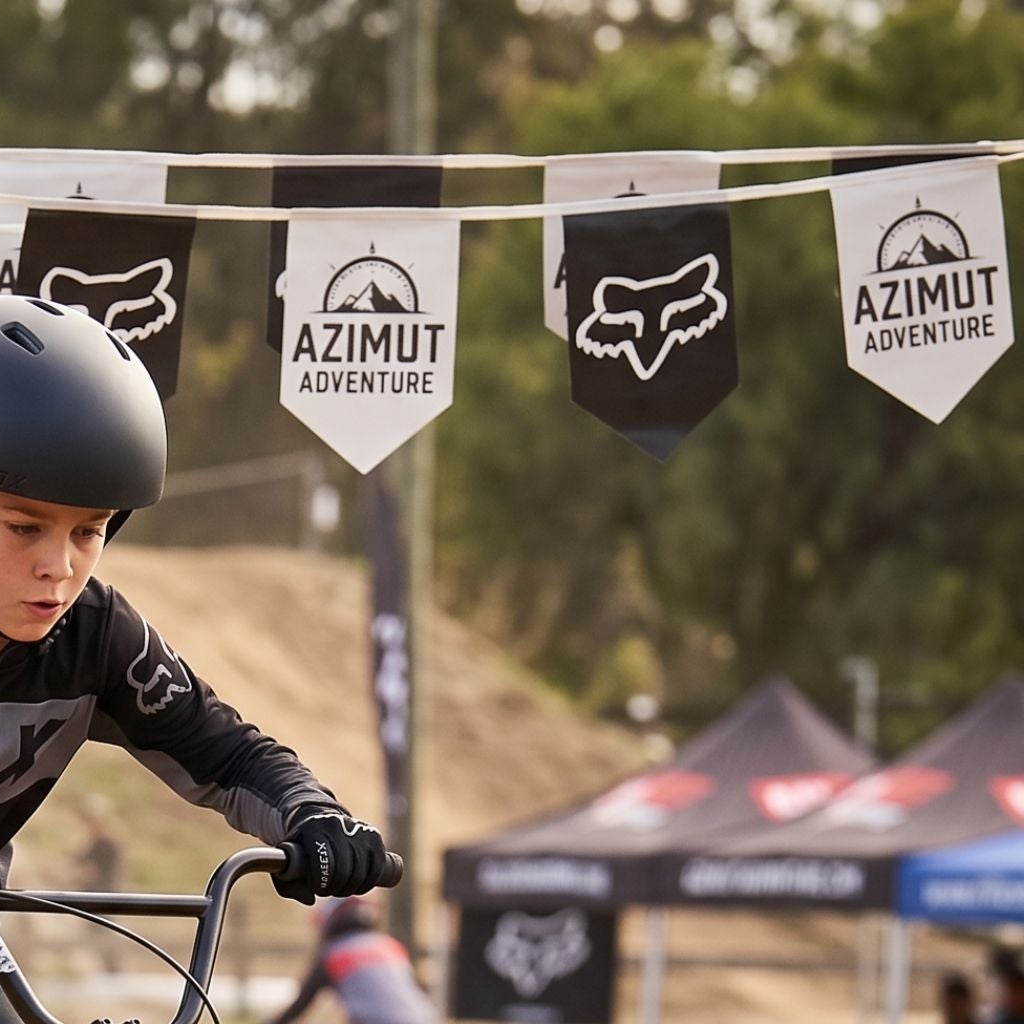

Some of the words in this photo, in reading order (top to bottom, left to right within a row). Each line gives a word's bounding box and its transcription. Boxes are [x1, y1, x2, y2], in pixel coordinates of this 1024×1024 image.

[854, 266, 998, 325] AZIMUT
[292, 323, 445, 363] AZIMUT
[864, 313, 995, 354] ADVENTURE
[299, 371, 434, 394] ADVENTURE
